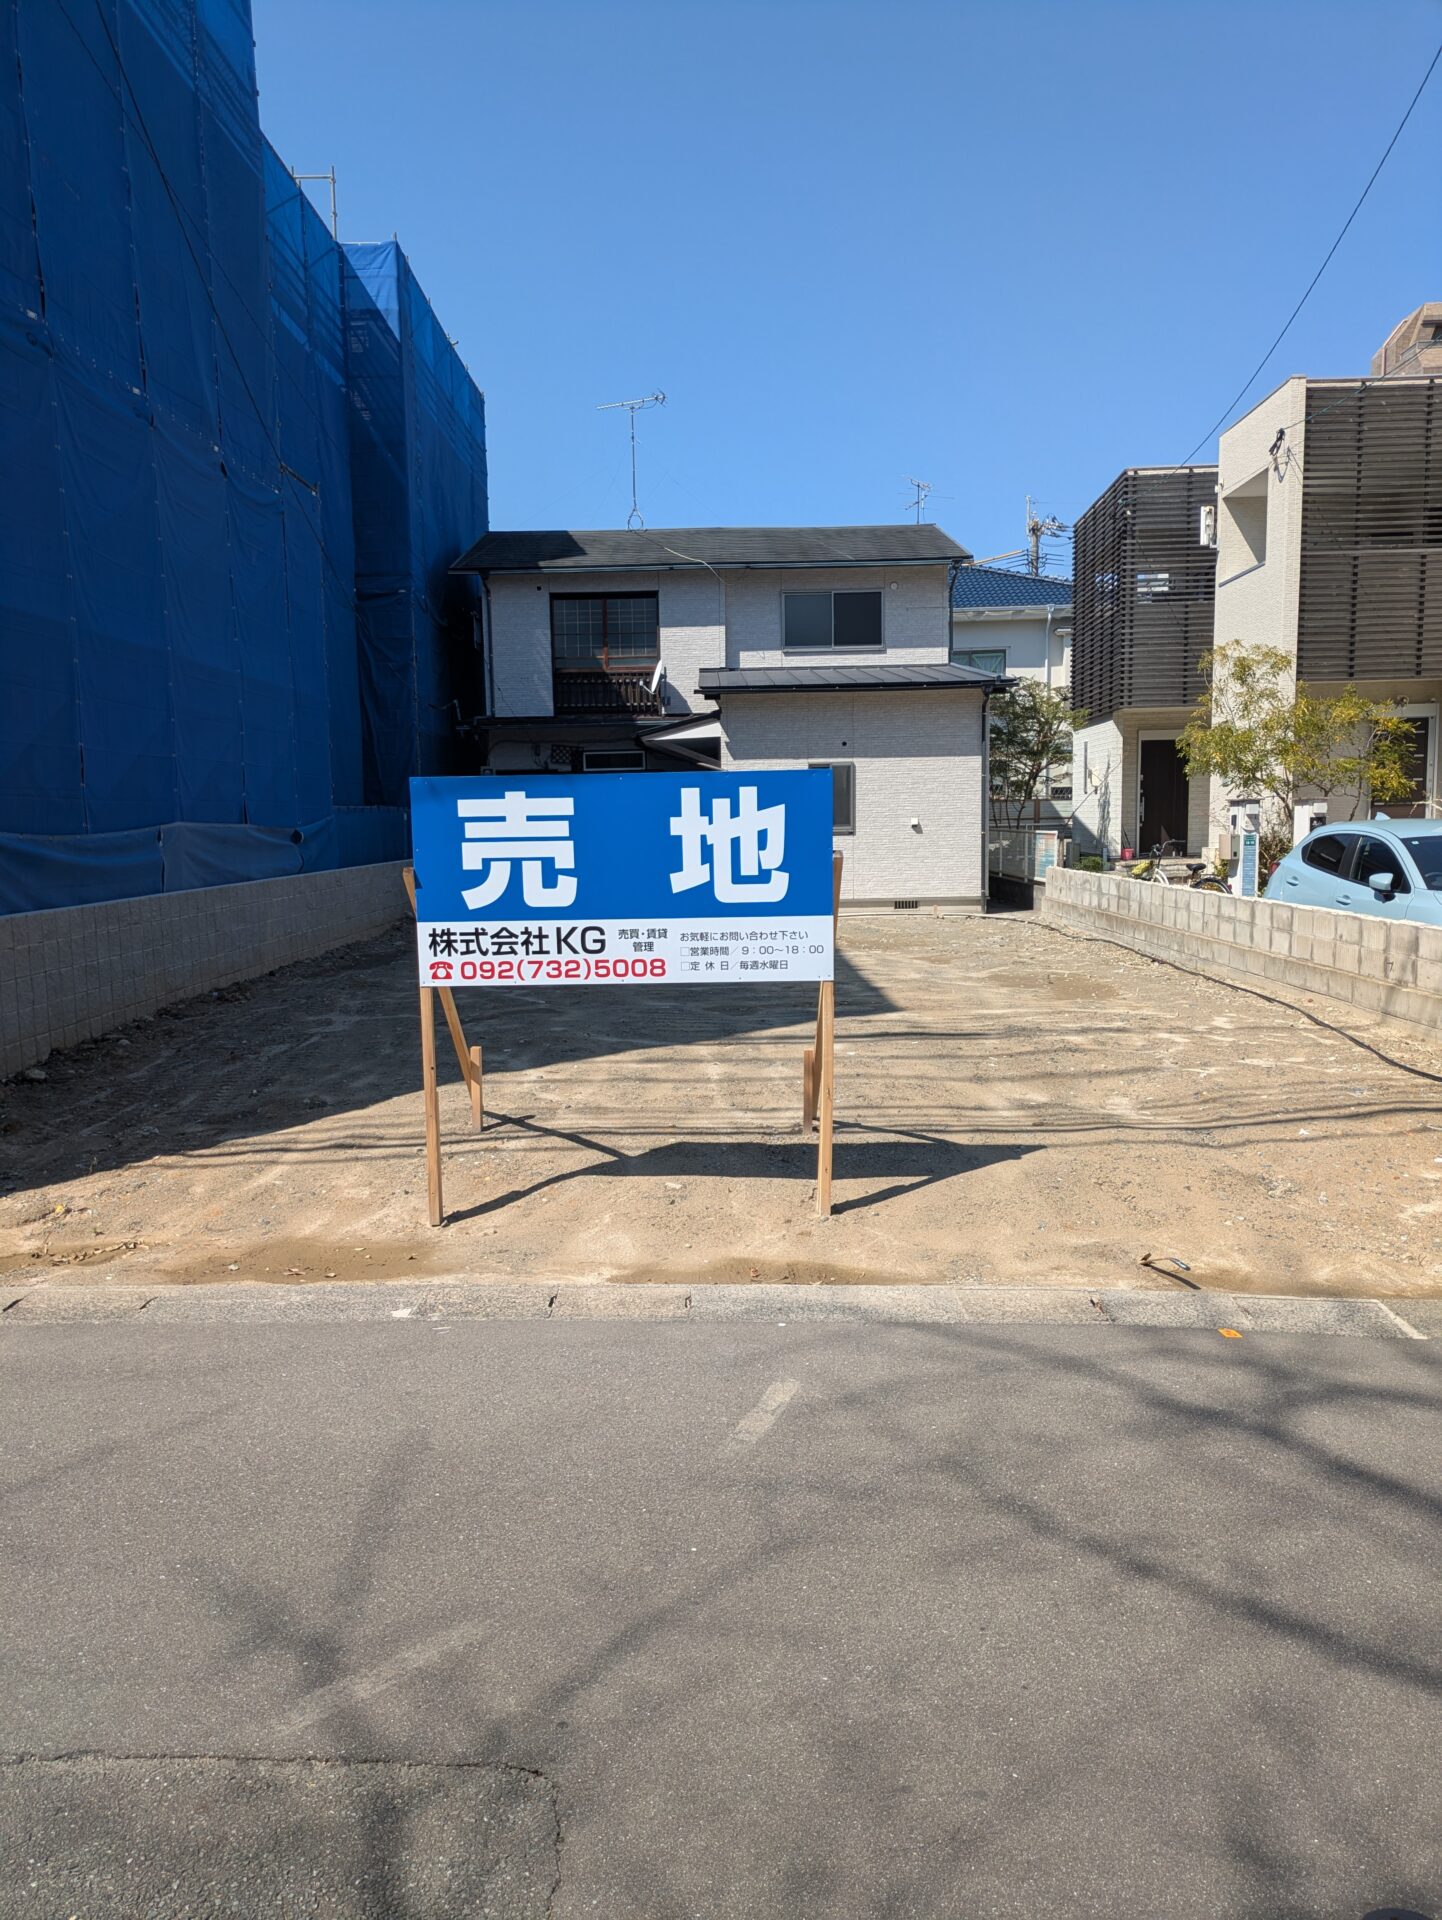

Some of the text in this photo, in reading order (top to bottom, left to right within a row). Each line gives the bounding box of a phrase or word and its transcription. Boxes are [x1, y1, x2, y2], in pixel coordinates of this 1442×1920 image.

[617, 928, 668, 940] 売買・賃貸
[680, 930, 809, 942] お気軽にお問い合わせ下さい
[428, 925, 606, 958] 株式会社KG
[632, 941, 655, 953] 管理
[460, 958, 667, 981] 092(732)5008
